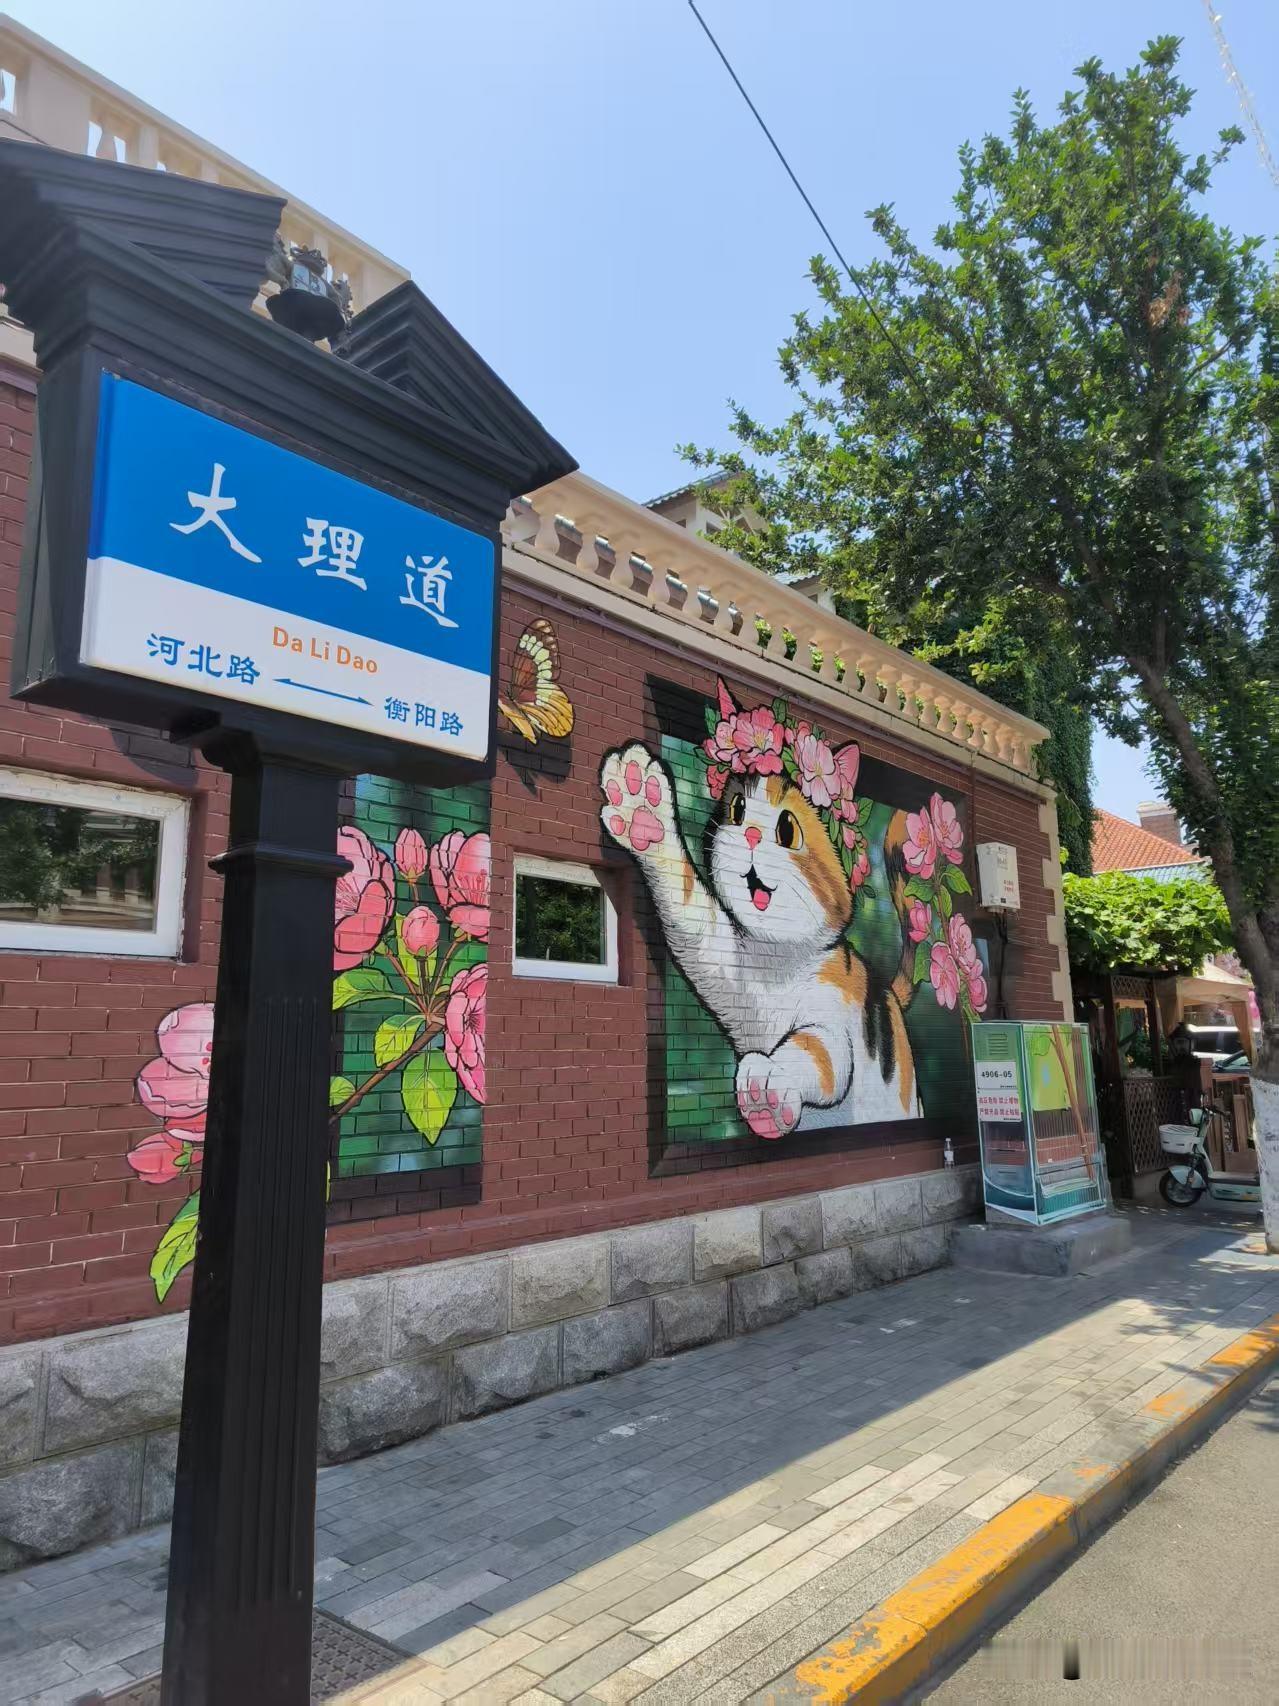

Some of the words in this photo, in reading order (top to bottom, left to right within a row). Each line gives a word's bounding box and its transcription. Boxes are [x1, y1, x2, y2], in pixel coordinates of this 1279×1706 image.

[169, 463, 459, 628] 大理道
[146, 633, 260, 685] 河北路
[384, 697, 464, 737] 衡阳路
[272, 626, 303, 654] Da
[311, 637, 330, 661] Li
[336, 645, 378, 674] Dao
[981, 1070, 1013, 1078] 4906-05
